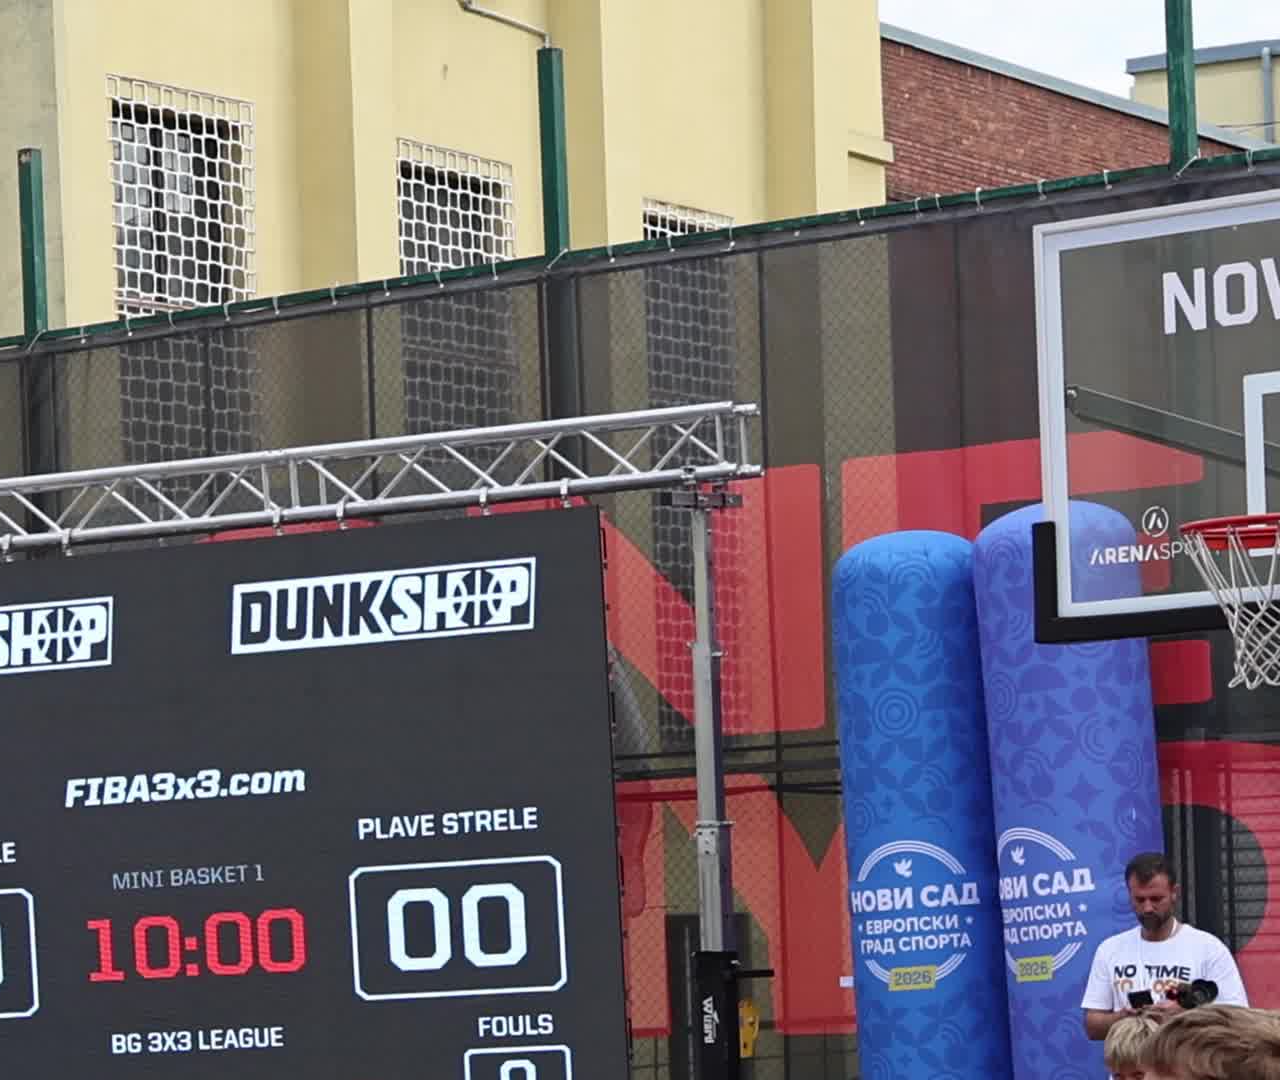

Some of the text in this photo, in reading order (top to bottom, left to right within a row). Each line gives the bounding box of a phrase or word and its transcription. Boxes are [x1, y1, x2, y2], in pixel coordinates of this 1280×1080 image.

[239, 565, 530, 645] DUNKSHOP
[65, 769, 306, 808] FIBA3x3.com
[357, 807, 538, 840] PLAVE STRELE
[112, 864, 265, 890] MINI BASKET 1
[1032, 867, 1096, 896] САД
[851, 882, 981, 913] НОВИ САД
[387, 882, 527, 971] 00
[865, 914, 959, 935] ЕВРОПСКИ
[1020, 920, 1088, 942] СПОРТА
[87, 908, 306, 982] 10:00
[861, 931, 972, 955] ГРАД СПОРТА
[1114, 965, 1192, 981] NO TIME
[478, 1013, 554, 1037] FOULS
[111, 1026, 284, 1054] BG 3X3 LEAGUE
